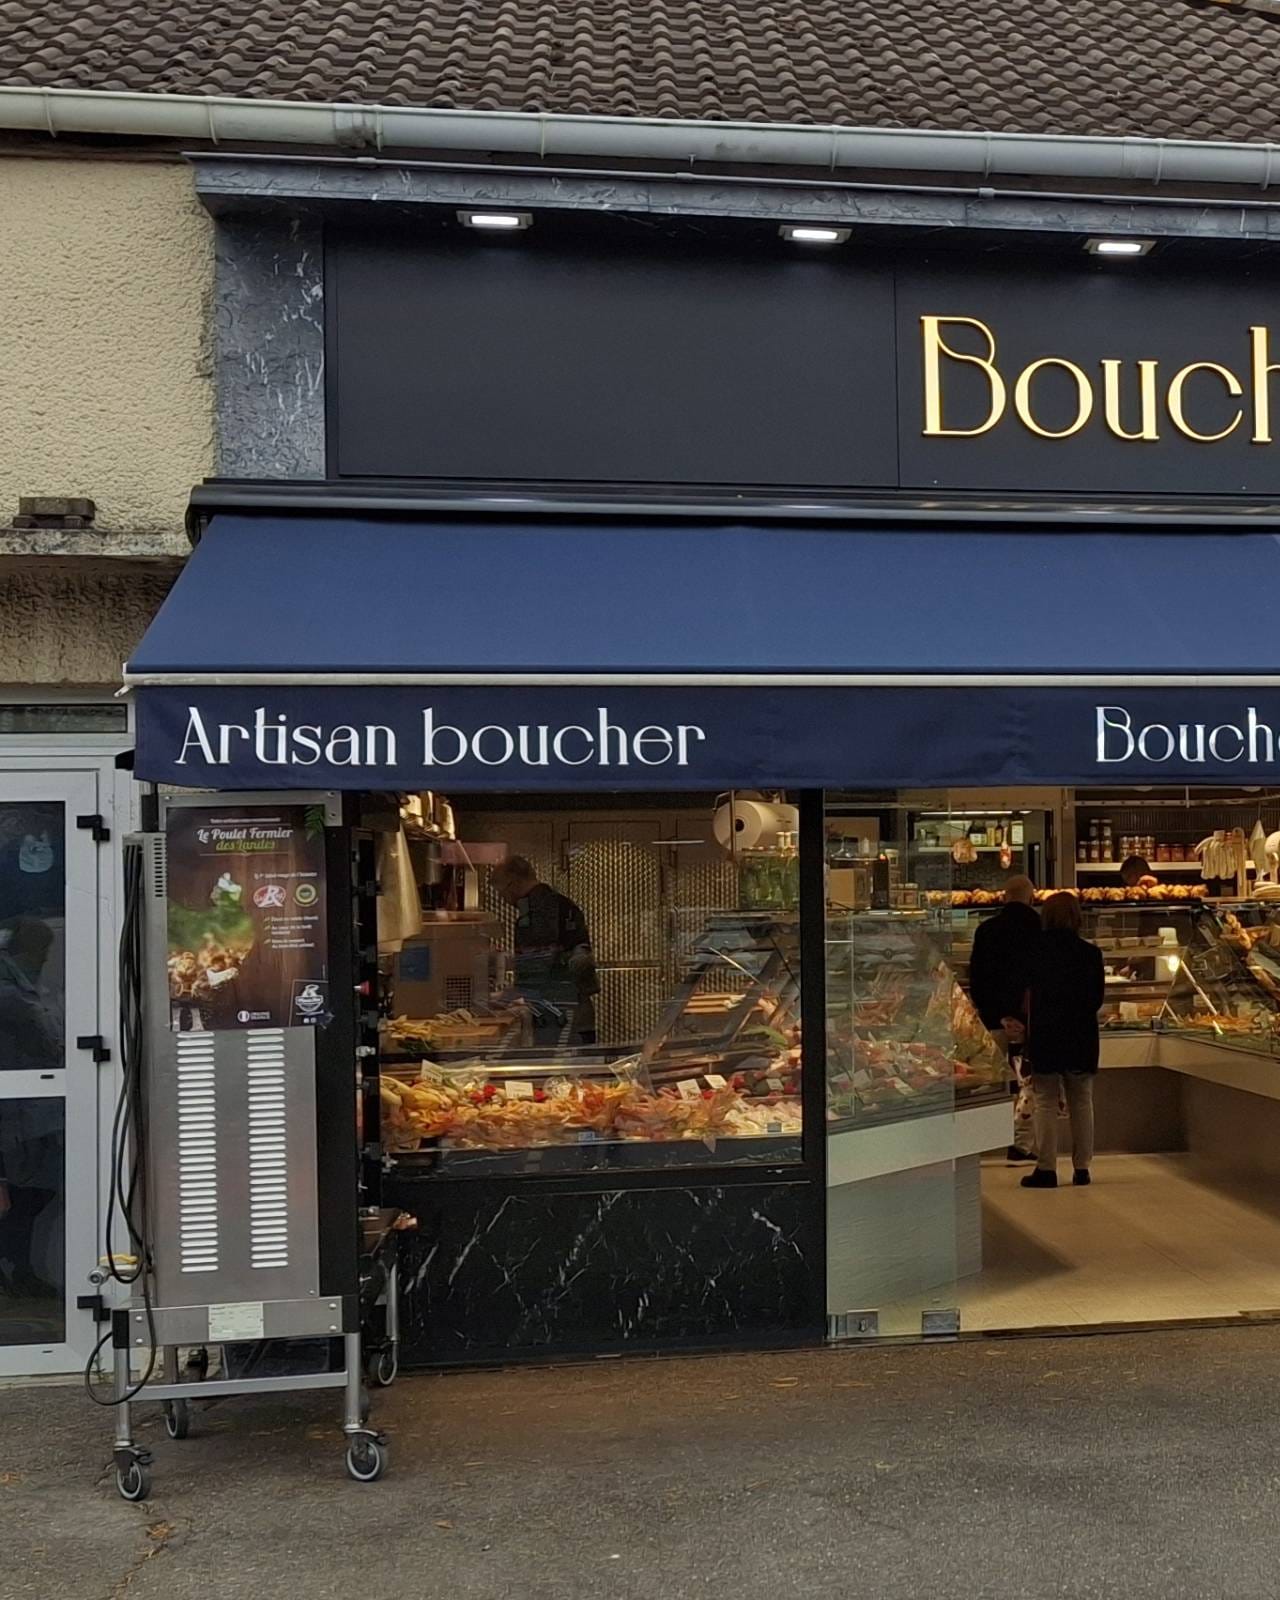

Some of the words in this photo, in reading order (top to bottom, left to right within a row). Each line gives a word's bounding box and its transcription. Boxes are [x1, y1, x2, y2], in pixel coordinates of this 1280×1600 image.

[175, 707, 397, 765] Artisan
[423, 708, 705, 765] boucher
[197, 829, 210, 844] Le
[211, 828, 248, 840] Poulet
[249, 827, 294, 839] Fermier
